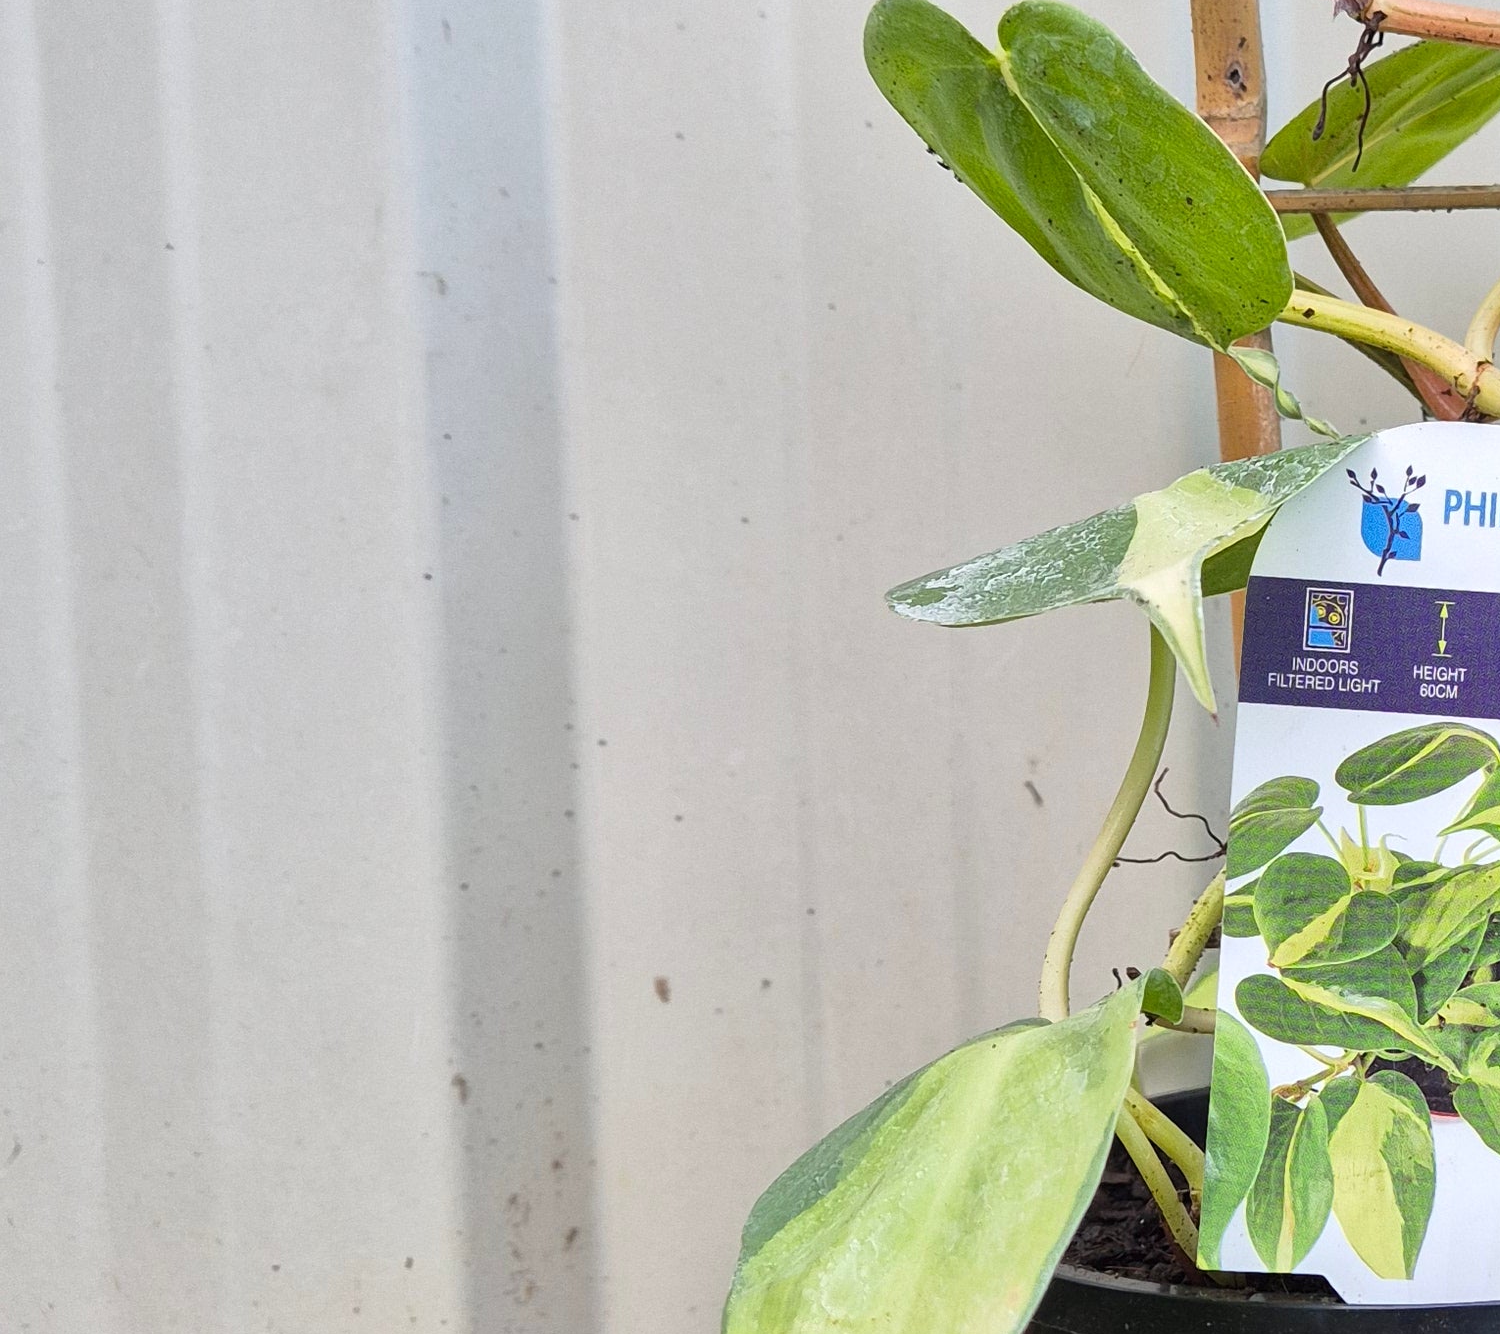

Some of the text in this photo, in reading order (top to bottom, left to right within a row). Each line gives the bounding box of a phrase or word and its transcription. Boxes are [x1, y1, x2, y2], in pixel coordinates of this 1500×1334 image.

[1292, 656, 1359, 676] INDOORS
[1413, 664, 1468, 682] HEIGHT
[1268, 672, 1382, 694] FILTERED LIGHT
[1419, 683, 1459, 699] 60CM
